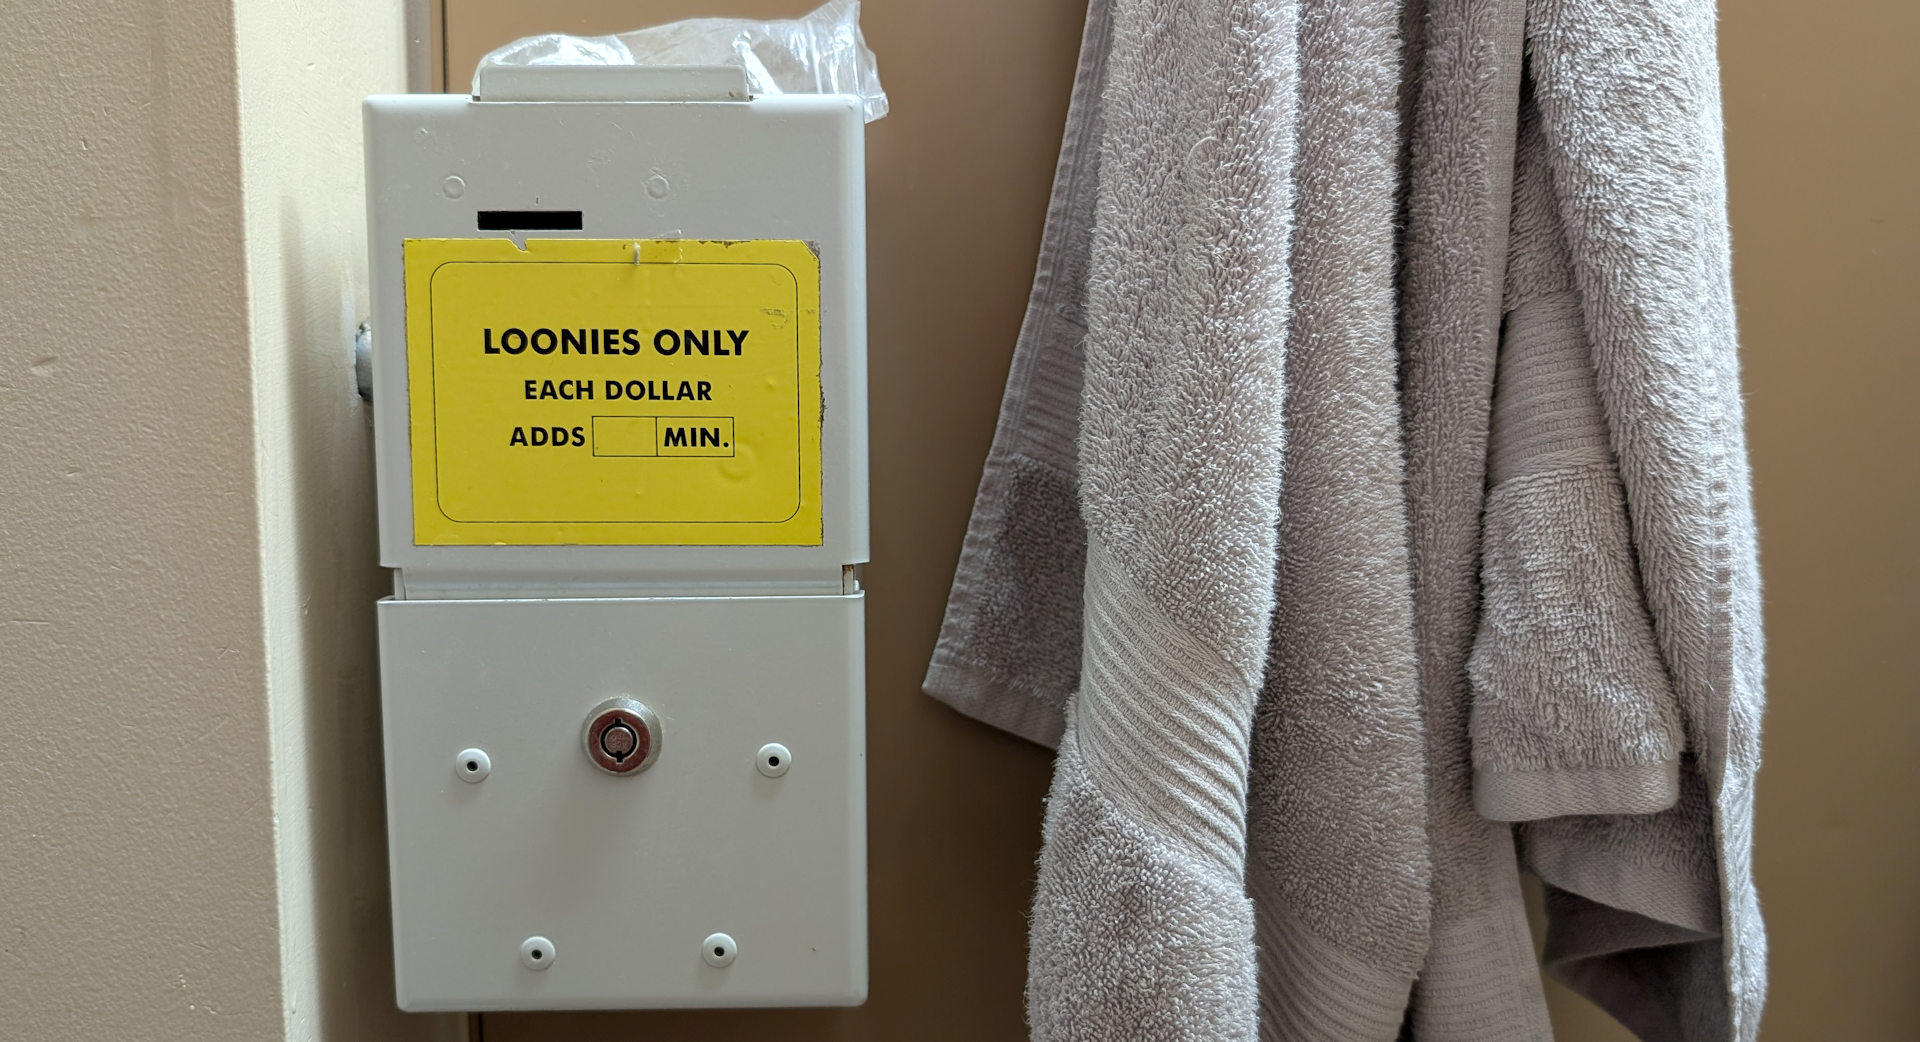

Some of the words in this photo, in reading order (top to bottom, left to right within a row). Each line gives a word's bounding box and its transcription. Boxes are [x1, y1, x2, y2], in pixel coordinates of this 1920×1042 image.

[483, 327, 641, 356] LOONIES
[653, 328, 750, 356] ONLY
[524, 379, 594, 400] EACH
[605, 379, 713, 401] DOLLAR
[509, 426, 586, 447] ADDS
[663, 426, 730, 448] MIN.
